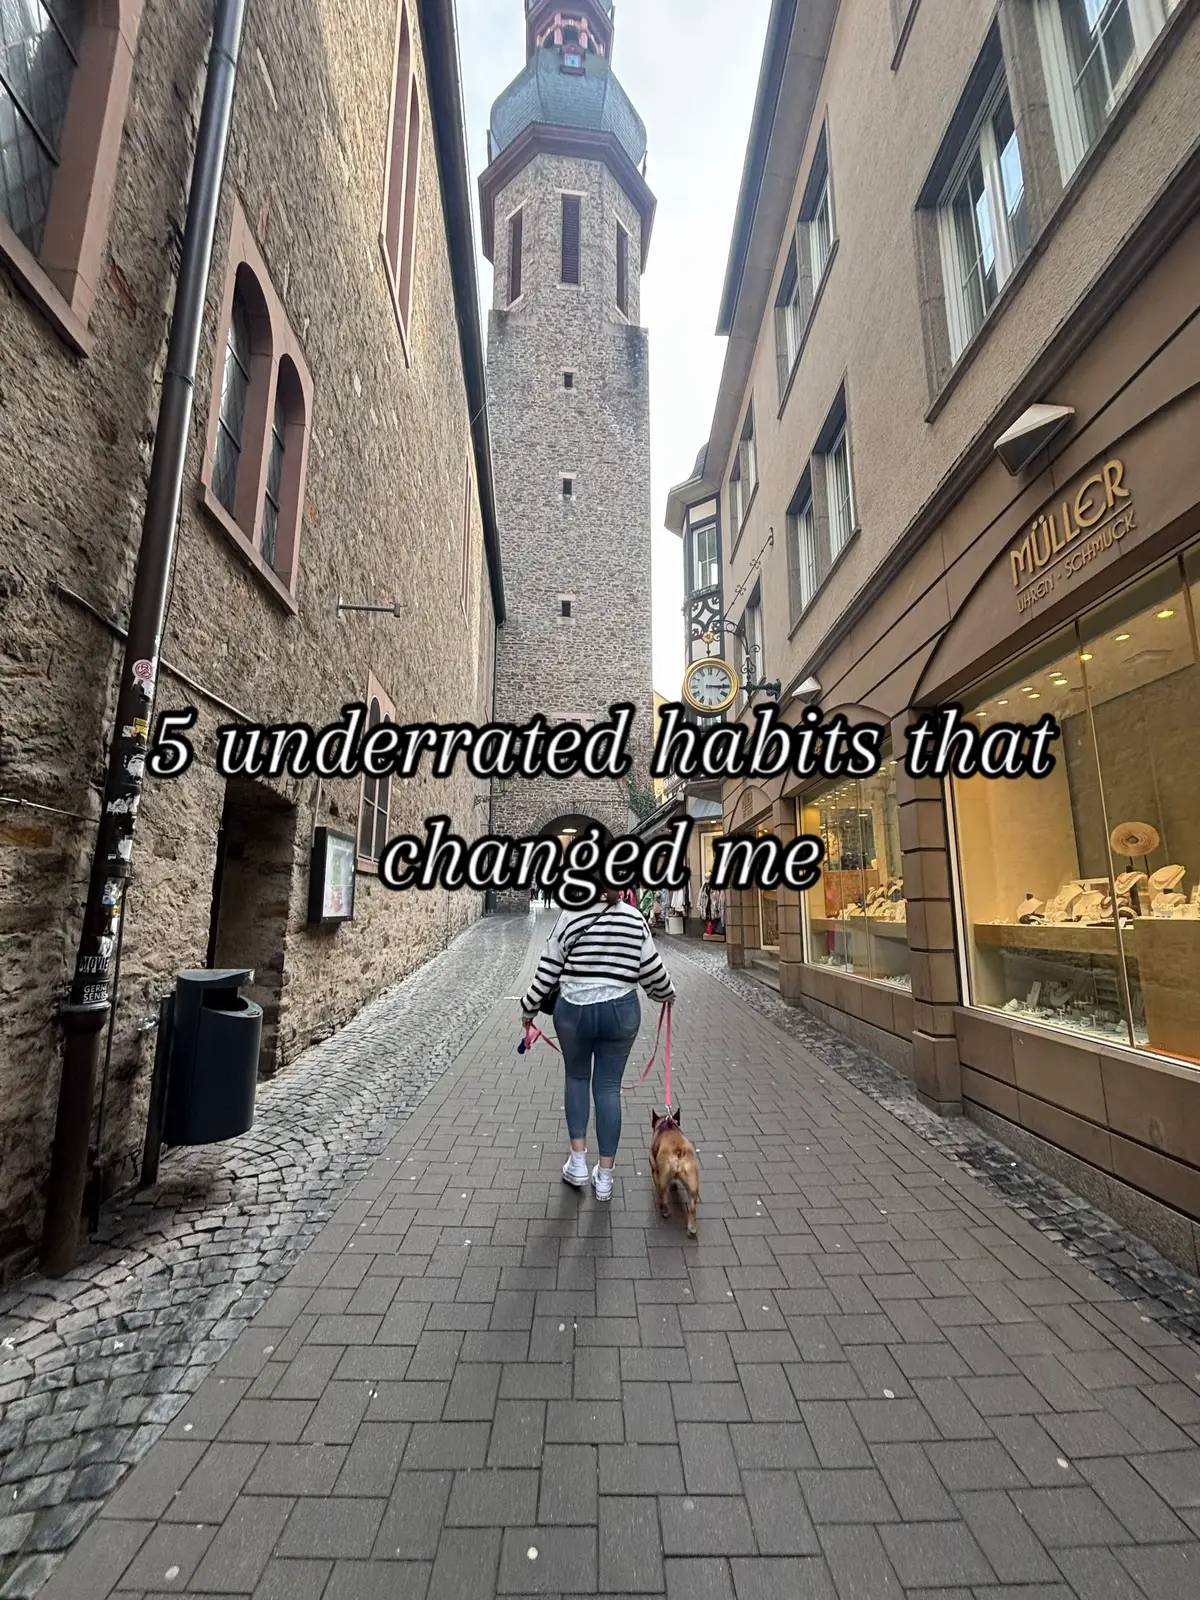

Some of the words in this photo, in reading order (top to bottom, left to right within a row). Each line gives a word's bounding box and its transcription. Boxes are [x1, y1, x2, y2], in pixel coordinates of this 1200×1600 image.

[1010, 459, 1130, 586] MÜLLER
[1017, 575, 1054, 613] UHREN
[1064, 510, 1137, 579] SCHMUCK
